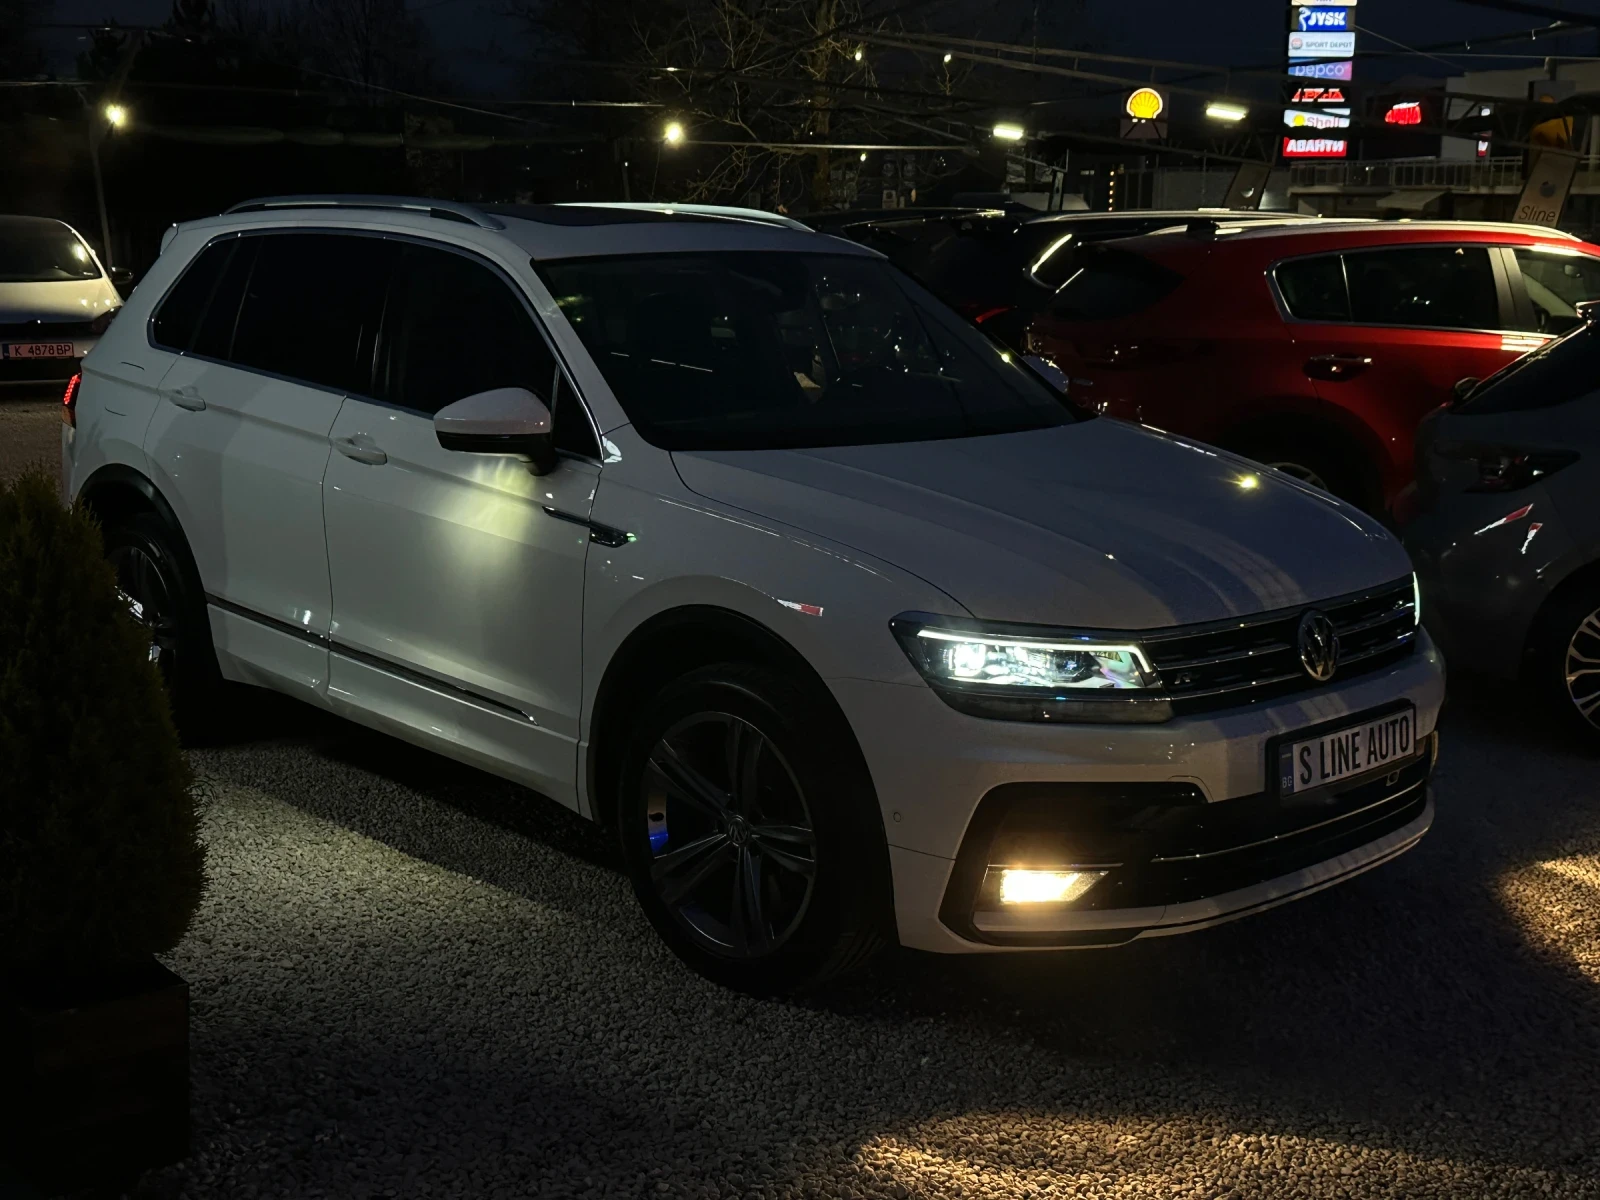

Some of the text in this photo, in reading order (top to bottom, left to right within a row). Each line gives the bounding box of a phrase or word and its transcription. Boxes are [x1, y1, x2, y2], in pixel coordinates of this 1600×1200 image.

[1307, 11, 1346, 26] JYSK
[1295, 64, 1345, 79] pepco
[1306, 116, 1340, 128] Shell
[1300, 714, 1410, 785] S LINE AUTO
